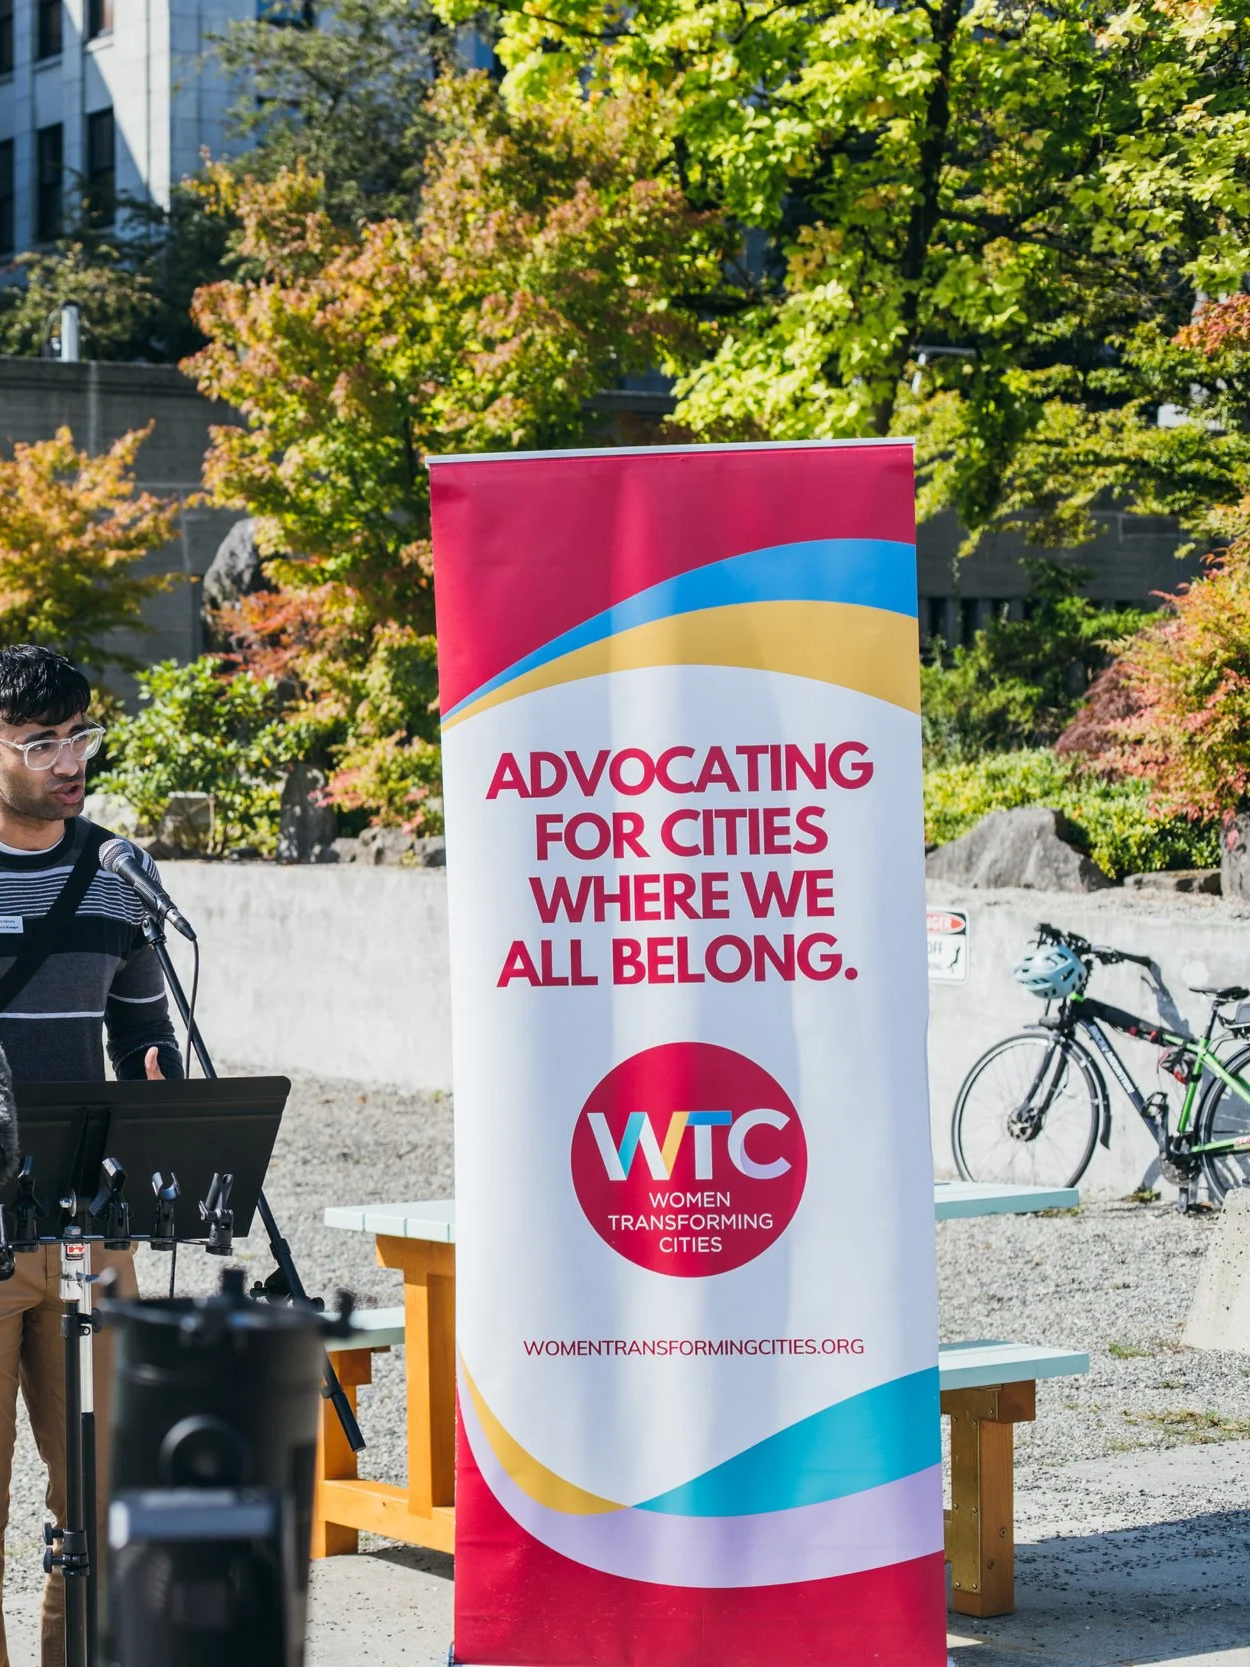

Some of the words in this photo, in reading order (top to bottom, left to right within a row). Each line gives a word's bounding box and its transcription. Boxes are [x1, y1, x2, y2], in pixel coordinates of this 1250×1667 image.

[485, 741, 874, 800] ADVOCATING
[536, 811, 651, 861] FOR
[660, 805, 829, 857] CITIES
[528, 873, 730, 924] WHERE
[740, 869, 835, 918] WE
[496, 938, 599, 988] ALL
[612, 932, 859, 985] BELONG.
[586, 1108, 792, 1181] WTC
[607, 1213, 774, 1231] TRANSFORMING
[648, 1191, 731, 1208] WOMEN
[659, 1236, 723, 1253] CITIES
[523, 1338, 865, 1356] WOMENTRANSFORMINGCITIES.ORG
